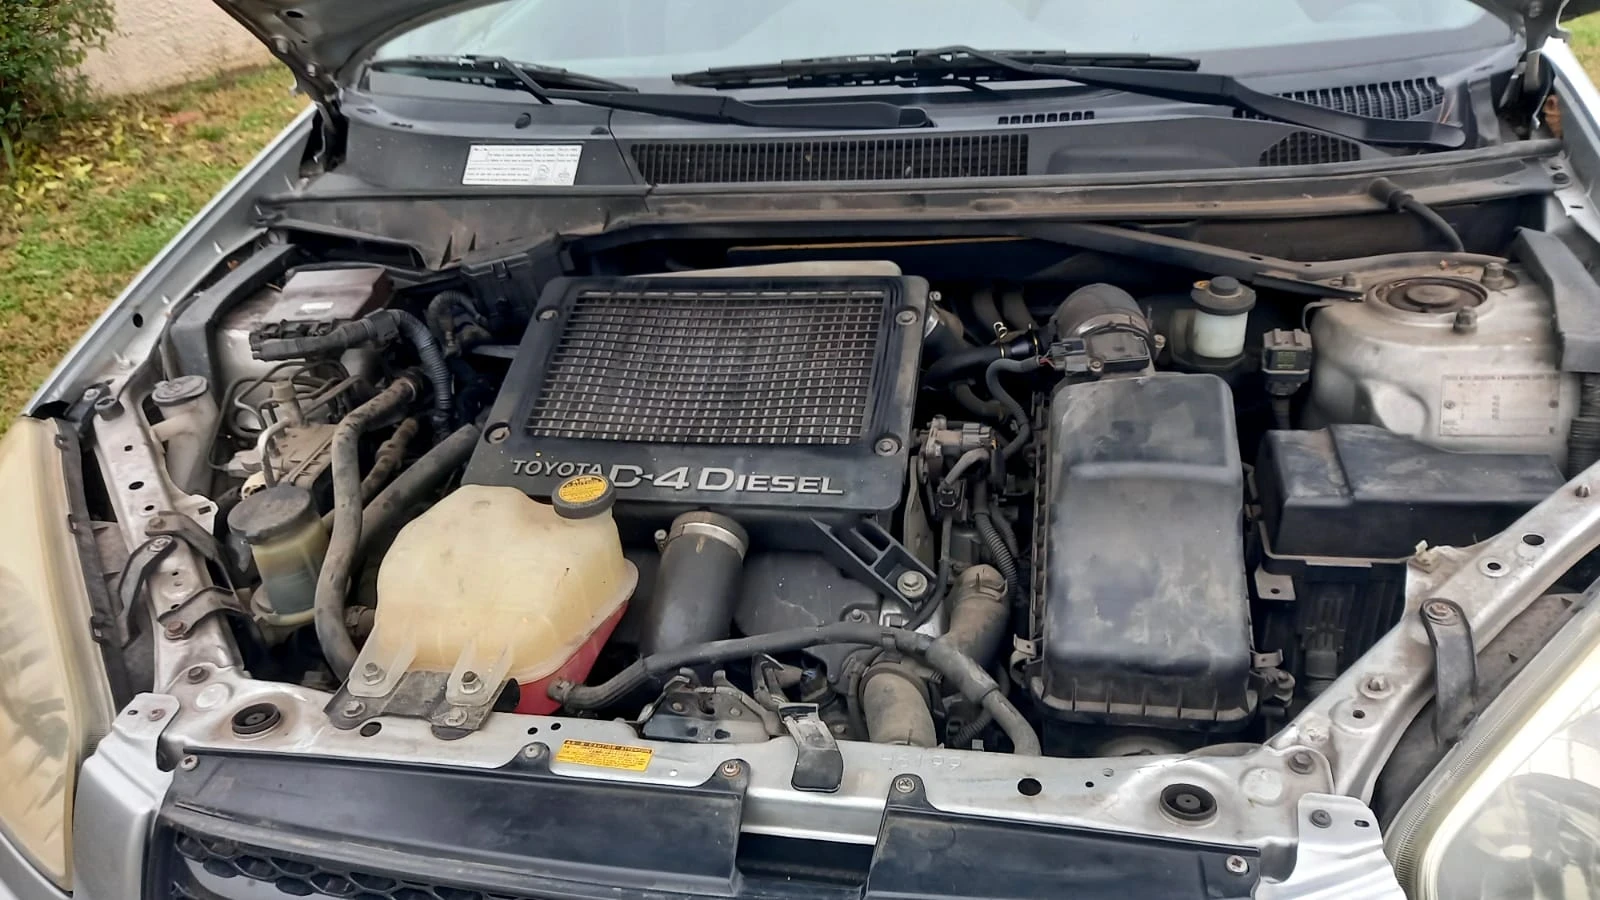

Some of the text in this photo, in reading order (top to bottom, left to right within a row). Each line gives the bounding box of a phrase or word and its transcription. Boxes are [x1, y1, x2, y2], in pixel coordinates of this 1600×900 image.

[513, 460, 604, 476] TOYOTA
[609, 464, 690, 490] D-4
[697, 467, 844, 495] DIESEL
